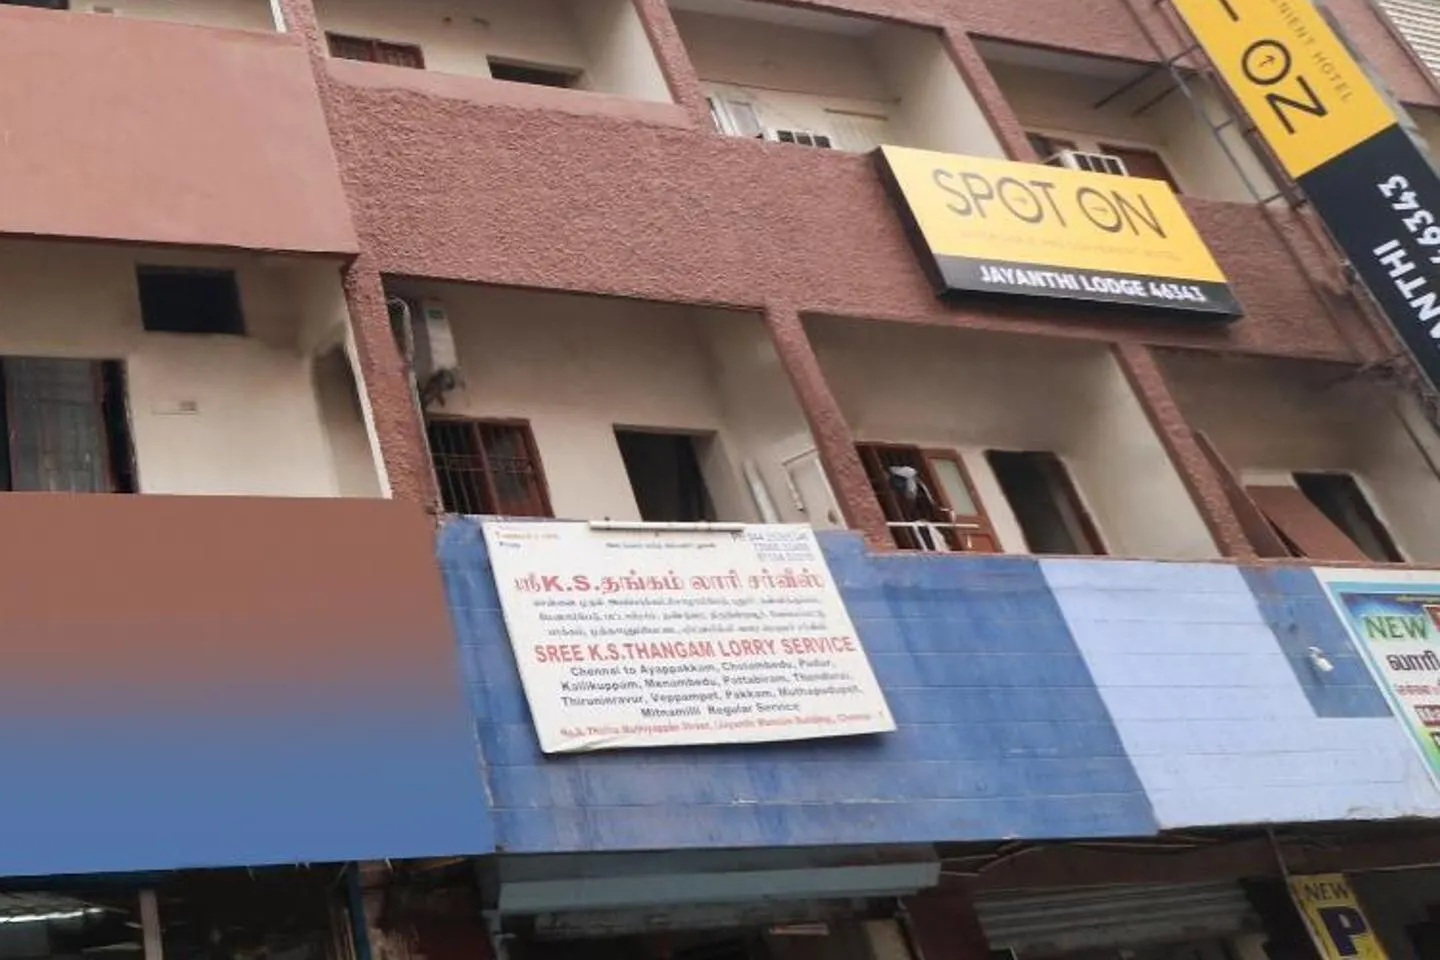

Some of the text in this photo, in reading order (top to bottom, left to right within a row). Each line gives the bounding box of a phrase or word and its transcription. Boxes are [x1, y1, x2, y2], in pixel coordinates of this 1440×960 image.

[1241, 39, 1329, 135] ON
[1313, 51, 1354, 103] HOTEL
[932, 168, 1167, 239] SPOT ON
[980, 264, 1078, 291] JAYANTHI
[1080, 275, 1152, 298] LODGE
[1363, 616, 1429, 640] NEW
[532, 635, 857, 663] SREE K.S.THANGAM LORRY SERVICE
[569, 665, 621, 677] Chennai
[623, 665, 638, 675] to
[705, 702, 754, 716] Regular
[755, 700, 801, 713] Service
[1304, 882, 1348, 900] NEW
